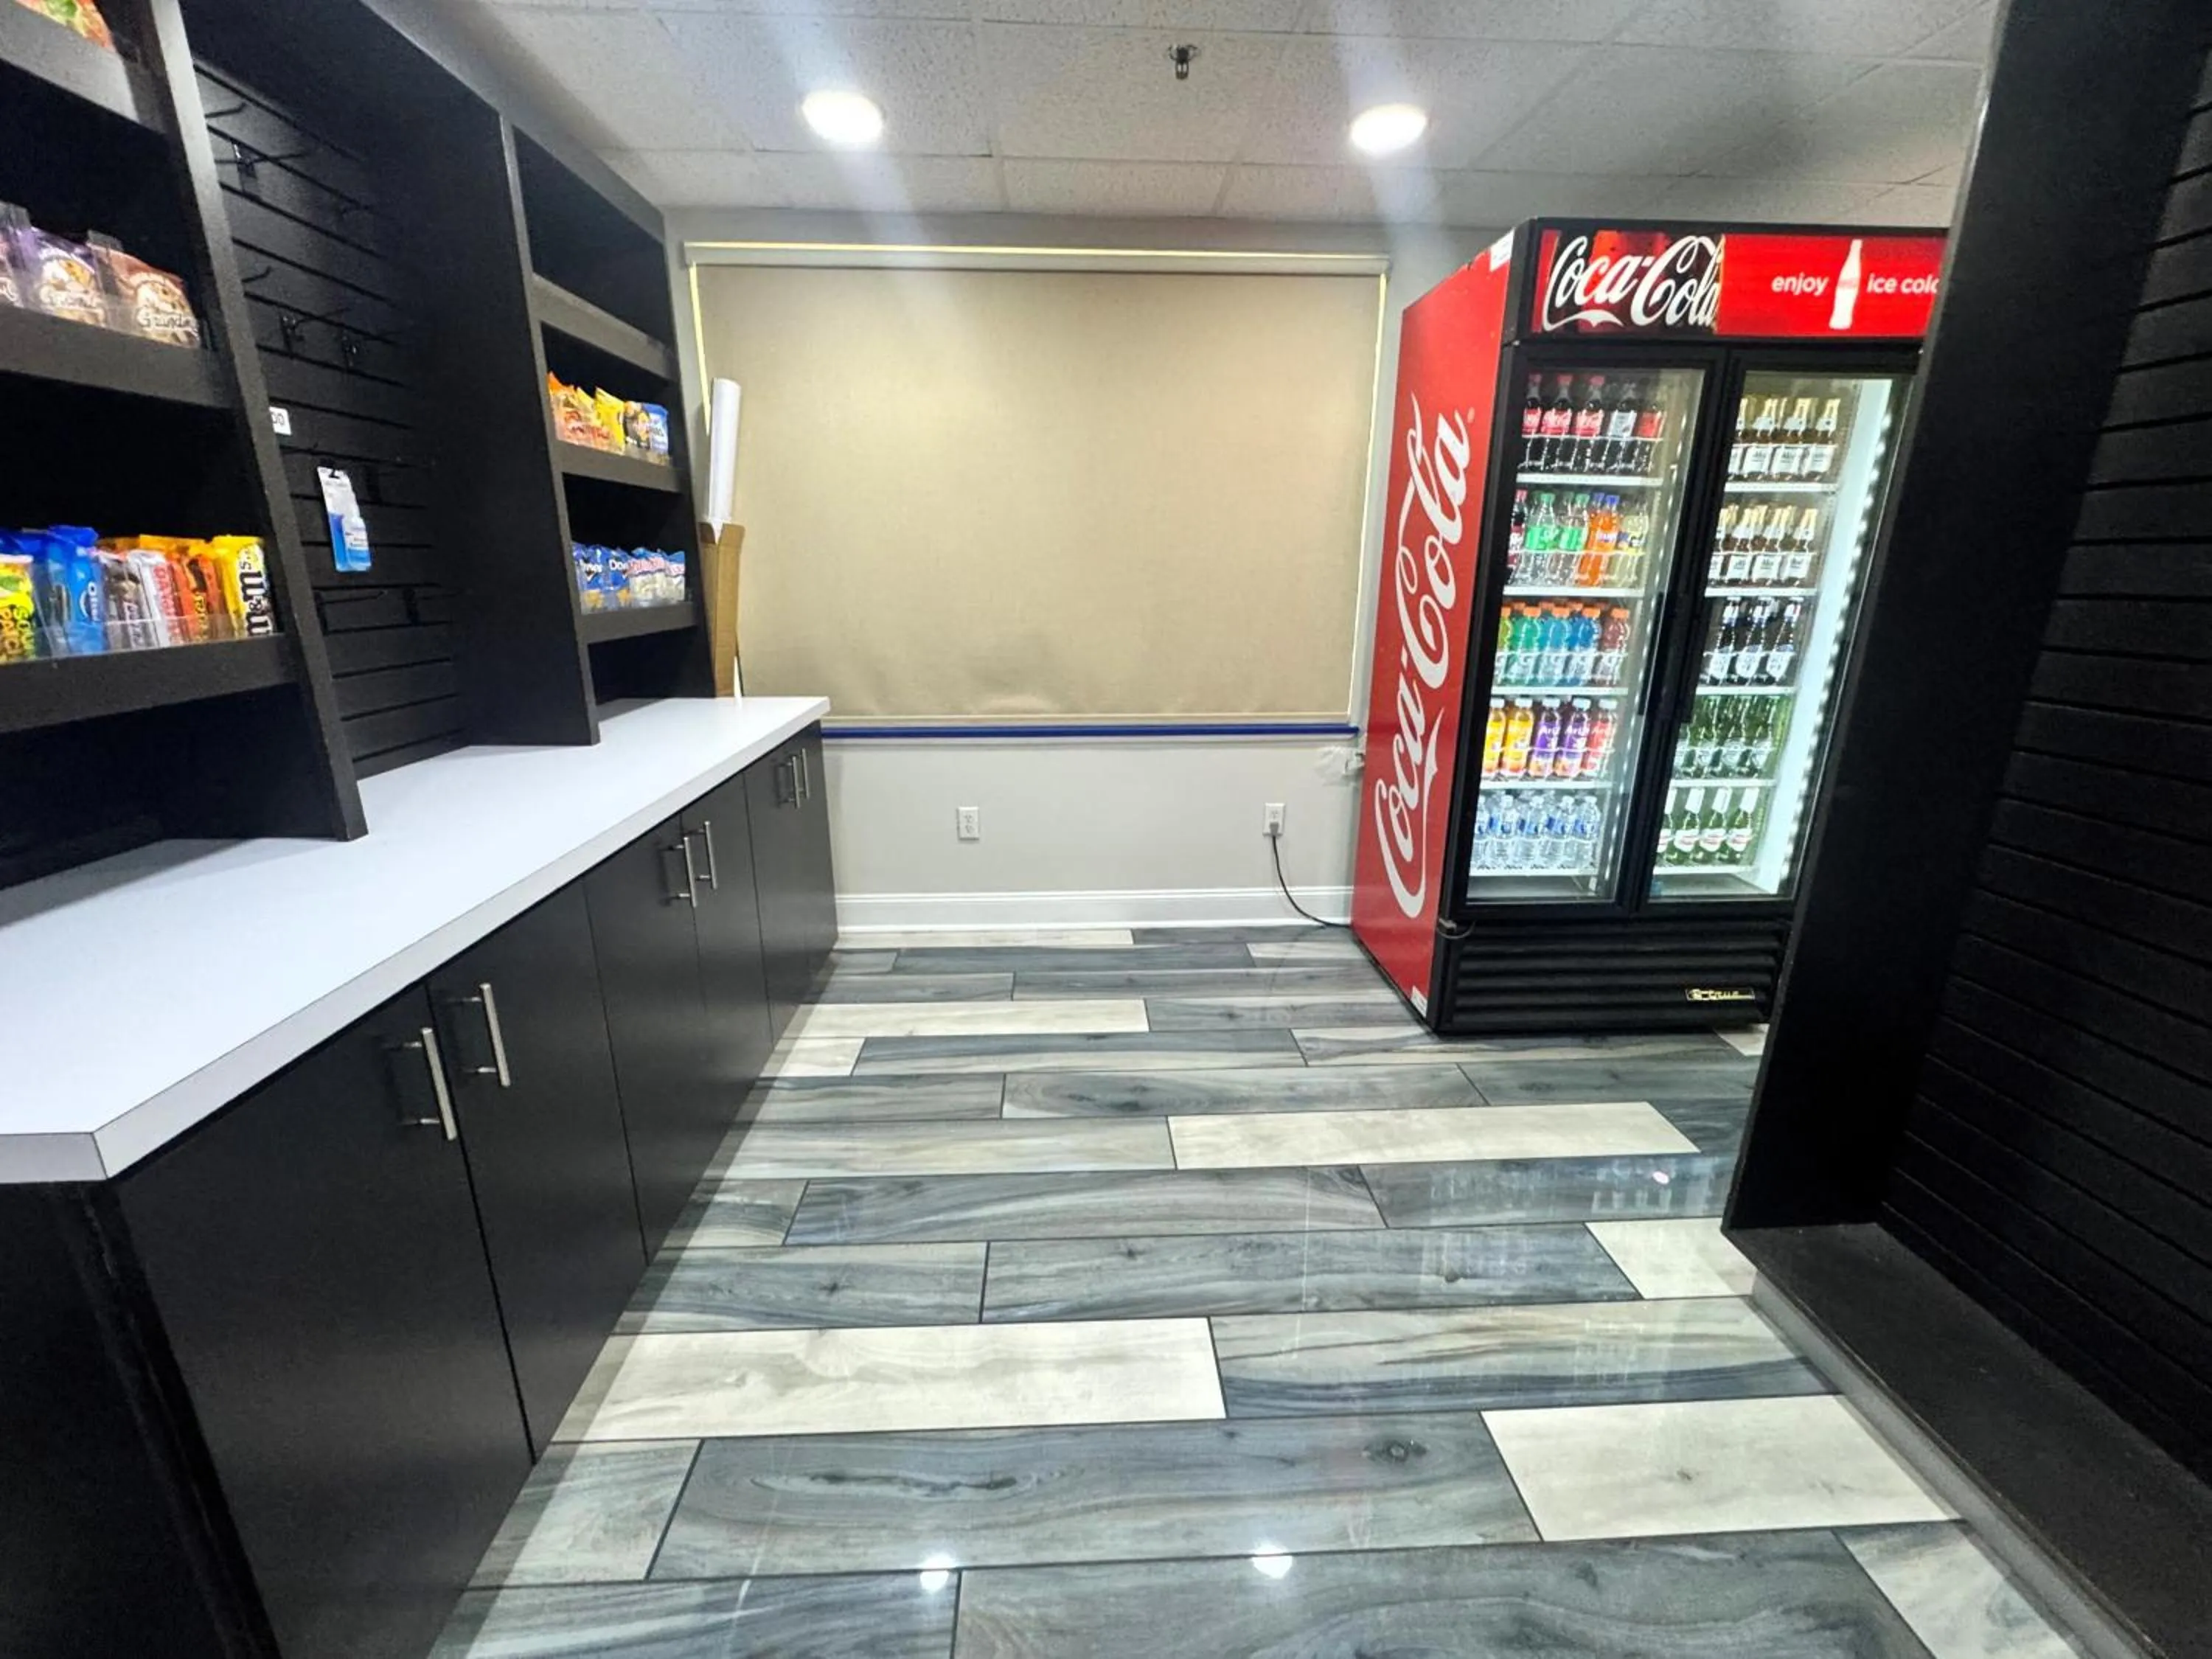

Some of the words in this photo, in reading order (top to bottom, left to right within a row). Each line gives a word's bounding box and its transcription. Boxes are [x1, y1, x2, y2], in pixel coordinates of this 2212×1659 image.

[1543, 235, 1721, 332] Coca-Cola
[1771, 272, 1829, 296] enjoy
[1866, 273, 1898, 293] ice
[1375, 389, 1471, 919] Coca-Cola
